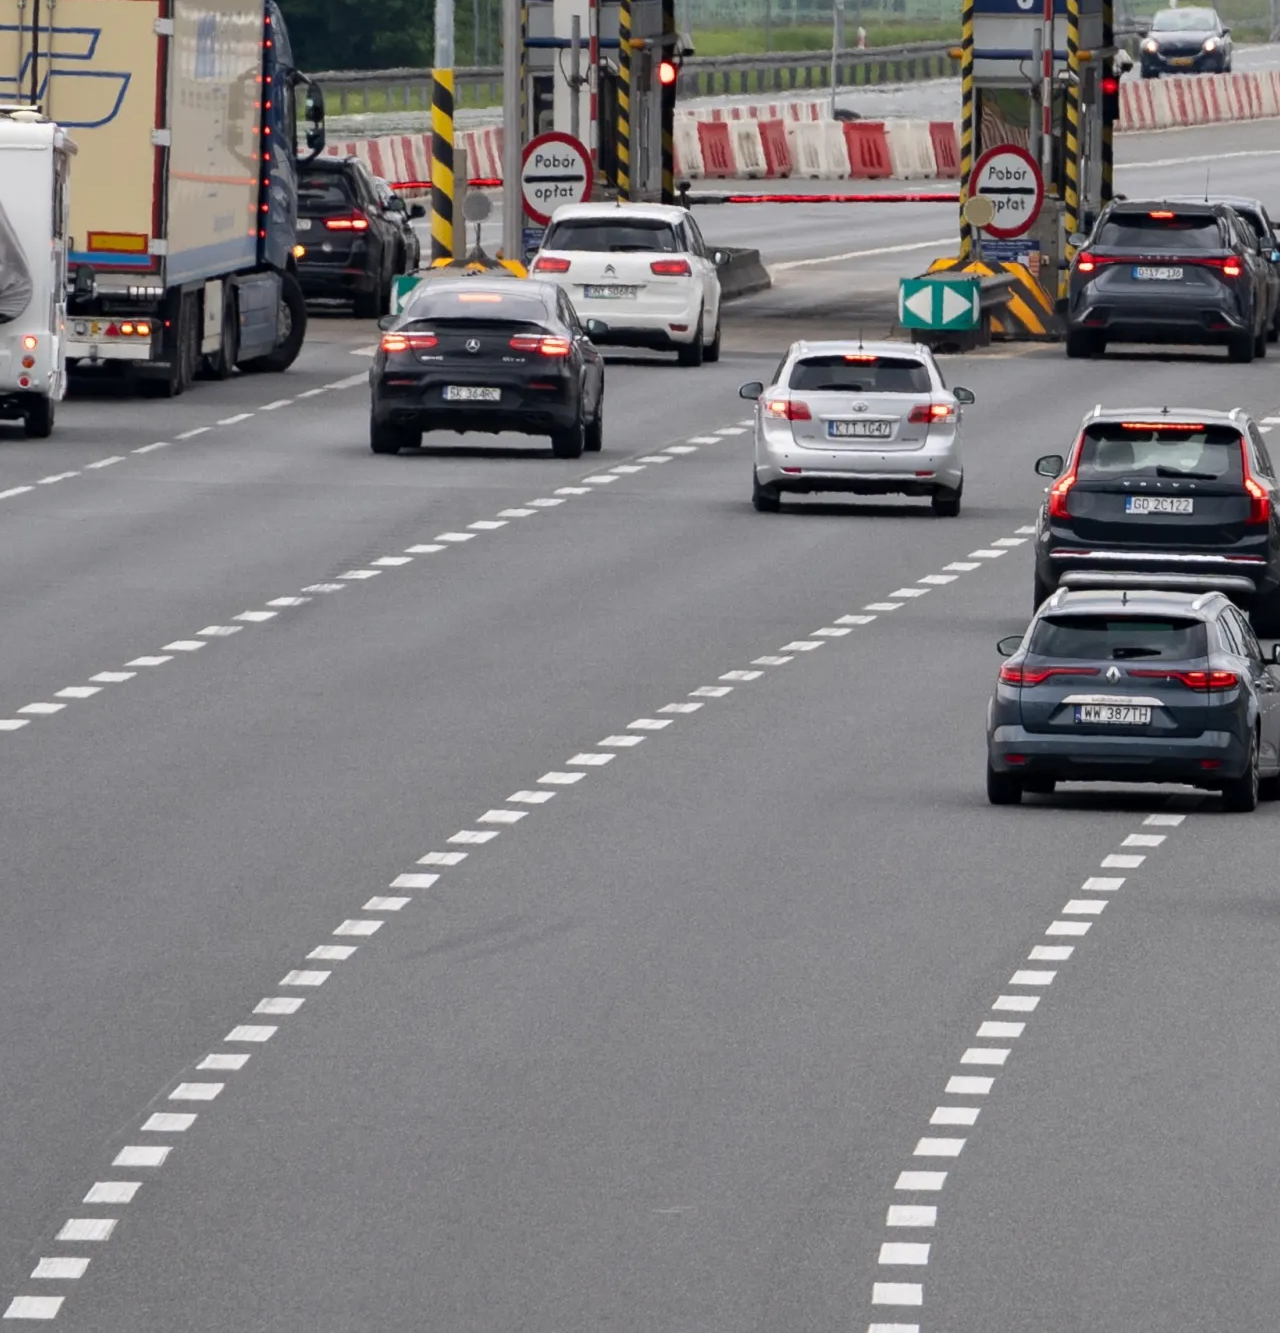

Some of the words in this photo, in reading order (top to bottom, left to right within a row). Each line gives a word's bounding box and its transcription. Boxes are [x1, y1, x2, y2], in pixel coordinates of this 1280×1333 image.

[535, 154, 576, 168] Pobór
[988, 166, 1028, 181] Pobór
[534, 184, 574, 203] opłat
[835, 421, 857, 434] KTT
[1133, 498, 1150, 510] GD
[1153, 498, 1191, 512] 2C122
[1084, 707, 1101, 719] WW
[1106, 707, 1149, 721] 387TH
